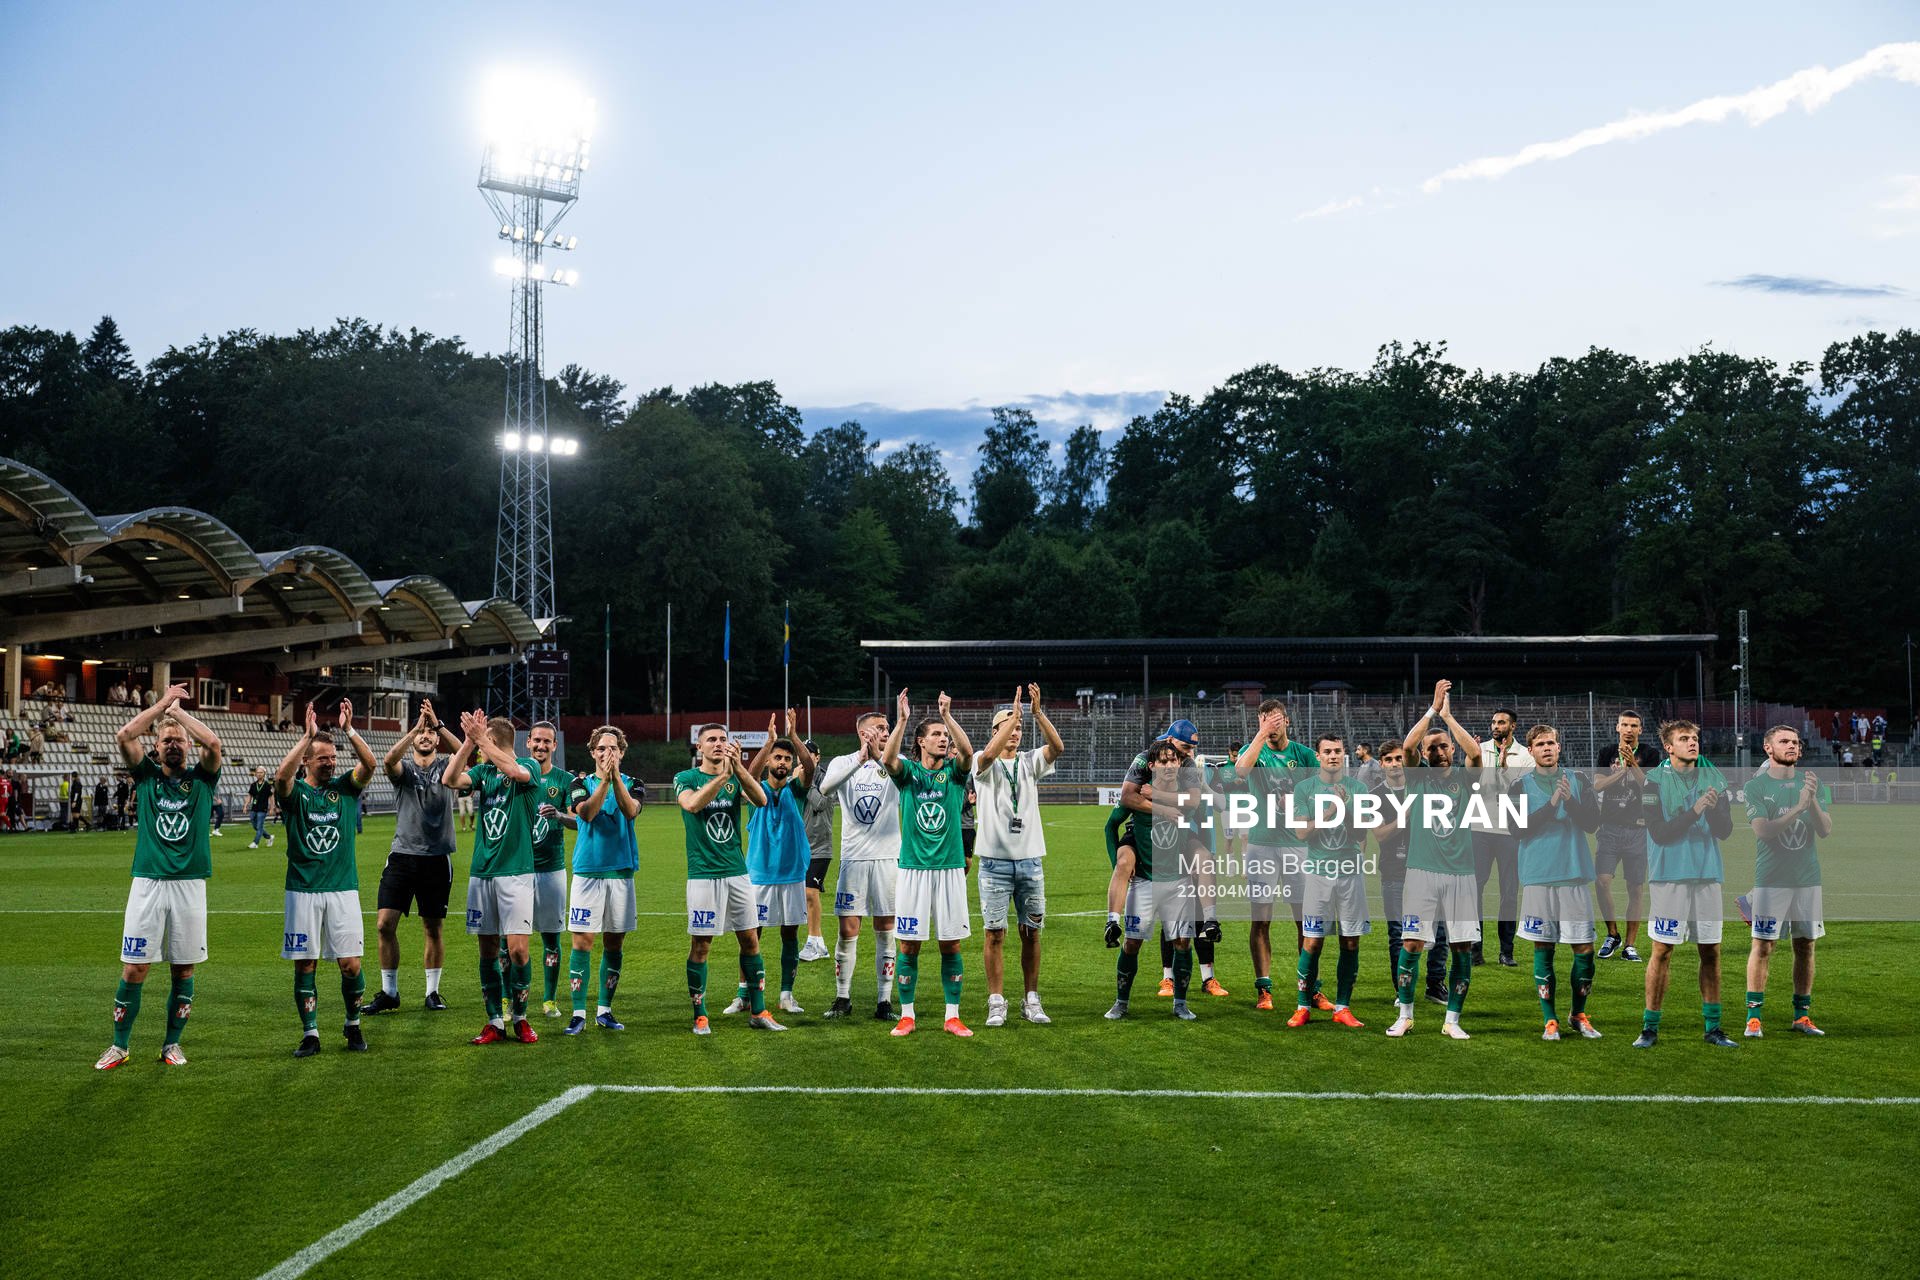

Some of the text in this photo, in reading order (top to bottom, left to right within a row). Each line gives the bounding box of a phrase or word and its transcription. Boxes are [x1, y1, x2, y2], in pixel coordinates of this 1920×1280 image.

[570, 907, 592, 922] NP
[693, 910, 716, 924] NP
[897, 916, 919, 930] NP
[1655, 916, 1679, 933] NP
[123, 936, 148, 952] NP
[284, 932, 308, 947] NP
